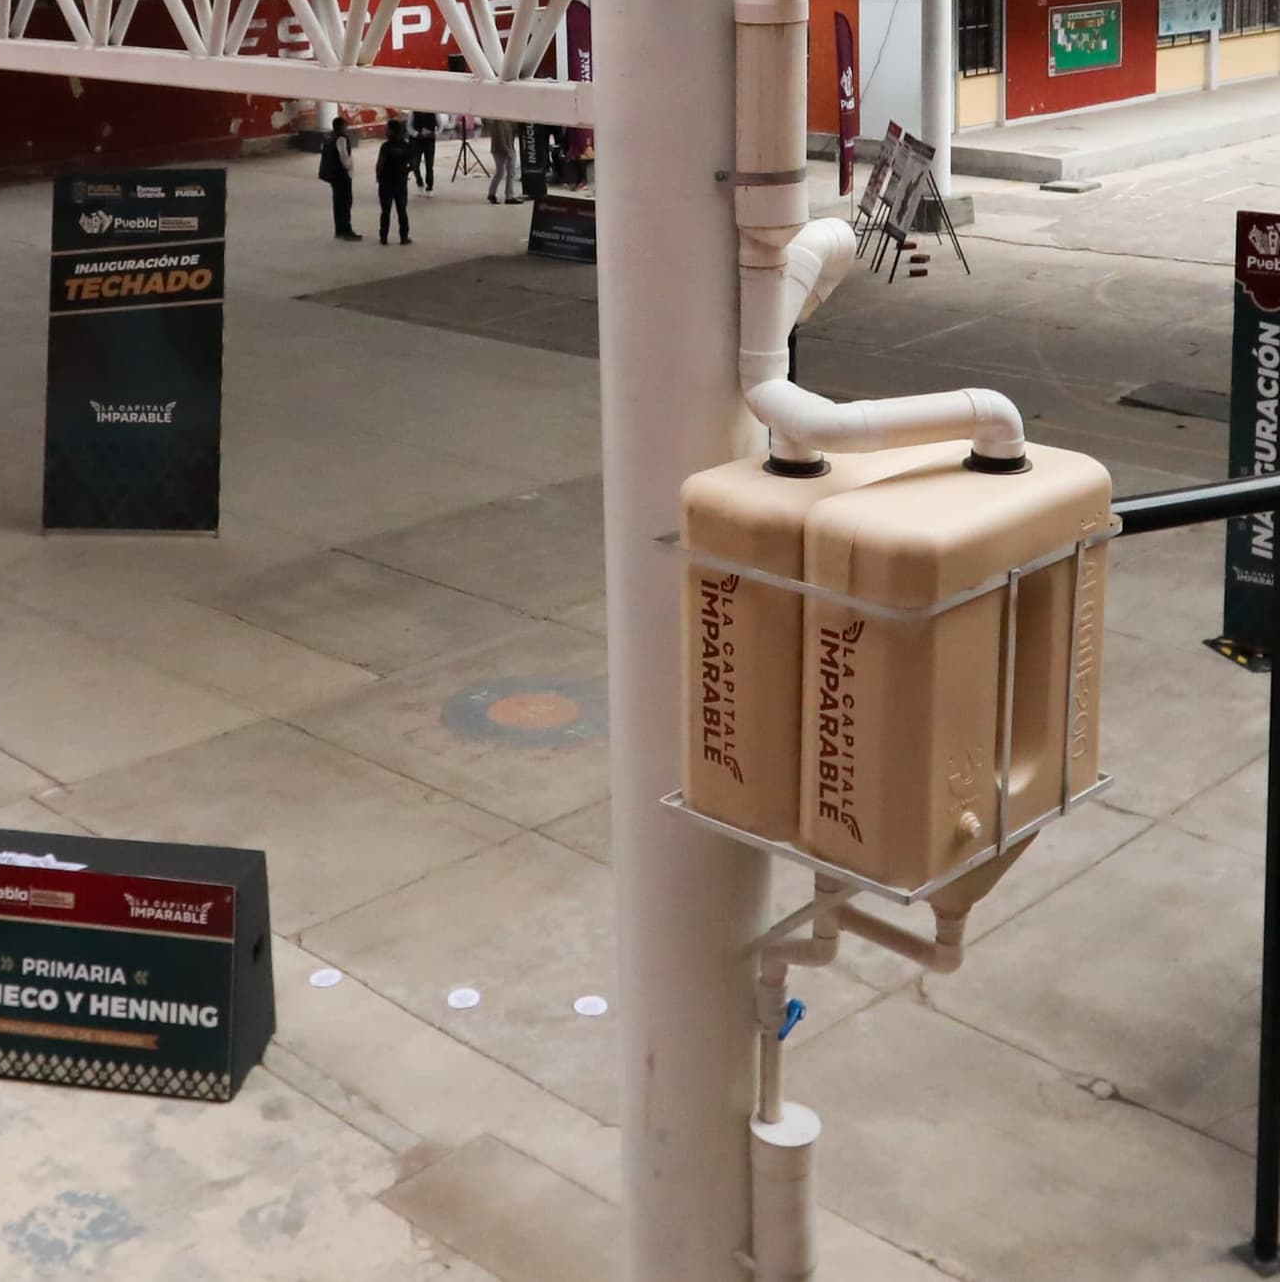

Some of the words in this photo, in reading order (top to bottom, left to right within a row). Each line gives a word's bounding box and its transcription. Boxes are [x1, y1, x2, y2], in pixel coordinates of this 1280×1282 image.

[114, 217, 158, 229] Puebla
[74, 255, 178, 274] INAUGURACIÓN
[180, 254, 200, 266] DE
[65, 268, 213, 300] TECHADO
[96, 412, 172, 423] IMPARABLE
[101, 404, 114, 412] LA
[118, 404, 165, 412] CAPITAL
[722, 597, 733, 626] LA
[701, 579, 723, 766] IMPARABLE
[842, 647, 855, 678] LA
[722, 641, 736, 751] CAPITAL
[819, 628, 840, 823] IMPARABLE
[842, 693, 855, 809] CAPITAL
[130, 906, 209, 925] IMPARABLE
[135, 898, 149, 907] LA
[153, 900, 201, 912] CAPITAL
[21, 957, 127, 986] PRIMARIA
[65, 990, 85, 1014] Y
[89, 993, 219, 1028] HENNING
